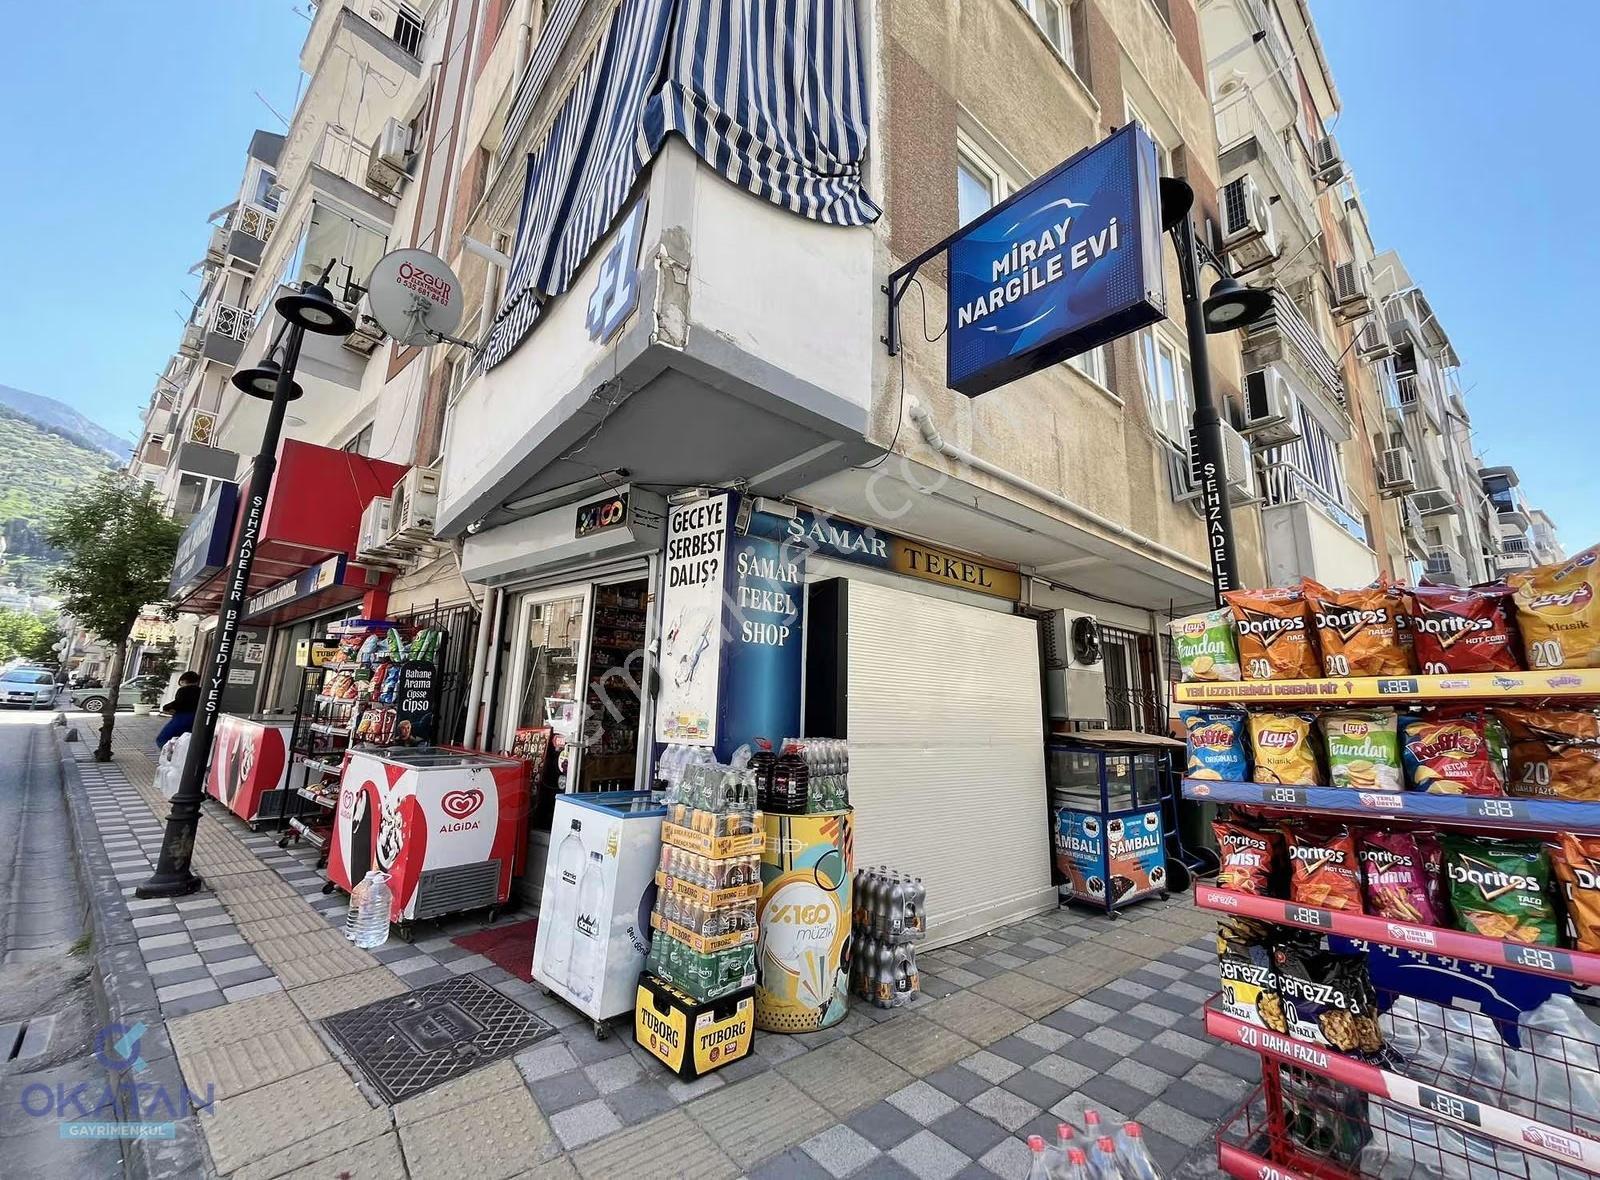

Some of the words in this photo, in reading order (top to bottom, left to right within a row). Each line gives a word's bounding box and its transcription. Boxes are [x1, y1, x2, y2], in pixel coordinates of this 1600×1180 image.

[992, 216, 1072, 283] MİRAY
[399, 261, 451, 300] ÖZGÜR
[958, 253, 1063, 329] NARGİLE
[1071, 216, 1119, 270] EVİ
[403, 280, 416, 291] 535
[417, 287, 430, 297] 681
[672, 501, 723, 535] GECEYE
[230, 496, 263, 602] ŞEHZADELER
[669, 529, 724, 562] SERBEST
[786, 516, 889, 558] ŞAMAR
[903, 546, 993, 589] TEKEL
[670, 558, 719, 590] DALIŞ?
[736, 552, 798, 585] ŞAMAR
[737, 586, 796, 615] TEKEL
[1236, 616, 1305, 635] Doritos
[1315, 608, 1387, 629] Doritos
[1415, 615, 1493, 633] Doritos
[1547, 620, 1590, 633] Klasik
[741, 620, 789, 648] SHOP
[1367, 628, 1394, 637] NACHO
[1465, 636, 1483, 645] HOT
[1484, 634, 1506, 644] CORN
[316, 650, 338, 658] TUBO
[205, 609, 238, 726] BELEDİYESİ
[405, 669, 432, 680] Bahane
[404, 679, 431, 689] Arama
[1185, 685, 1204, 697] YENİ
[407, 689, 428, 699] Cipsse
[402, 698, 429, 712] Cipso
[1343, 722, 1369, 736] Lay's
[1259, 730, 1298, 749] Lay's
[1407, 733, 1481, 762] Ruffles
[1204, 754, 1238, 764] ORIGINALS
[1266, 757, 1292, 766] Klasik
[440, 821, 480, 834] ALGİDA
[1055, 835, 1101, 856] AMBALİ
[1109, 831, 1160, 860] ŞAMBALİ
[1223, 834, 1266, 850] Doritos
[1224, 853, 1261, 867] TWIST
[1289, 845, 1345, 864] Doritos
[1359, 849, 1413, 867] Doritos
[1447, 862, 1540, 892] Doritos
[677, 883, 698, 899] TUBORG
[717, 891, 737, 902] TUBORG
[1517, 894, 1542, 905] TACO
[626, 926, 637, 942] geri
[671, 926, 692, 943] TUBORG
[796, 924, 834, 942] müzik
[710, 938, 732, 949] TUBORG
[1350, 938, 1370, 953] +1
[1378, 943, 1399, 958] +1
[1405, 949, 1429, 965] +1
[1438, 955, 1461, 972] +1
[1470, 963, 1495, 979] +1
[1232, 1007, 1251, 1019] FAZLA
[641, 1007, 679, 1049] TUBORG
[700, 1021, 746, 1050] TUBORG
[1296, 1024, 1317, 1040] FAZLA
[1262, 1032, 1291, 1054] DAHA
[1294, 1044, 1328, 1068] FAZLA
